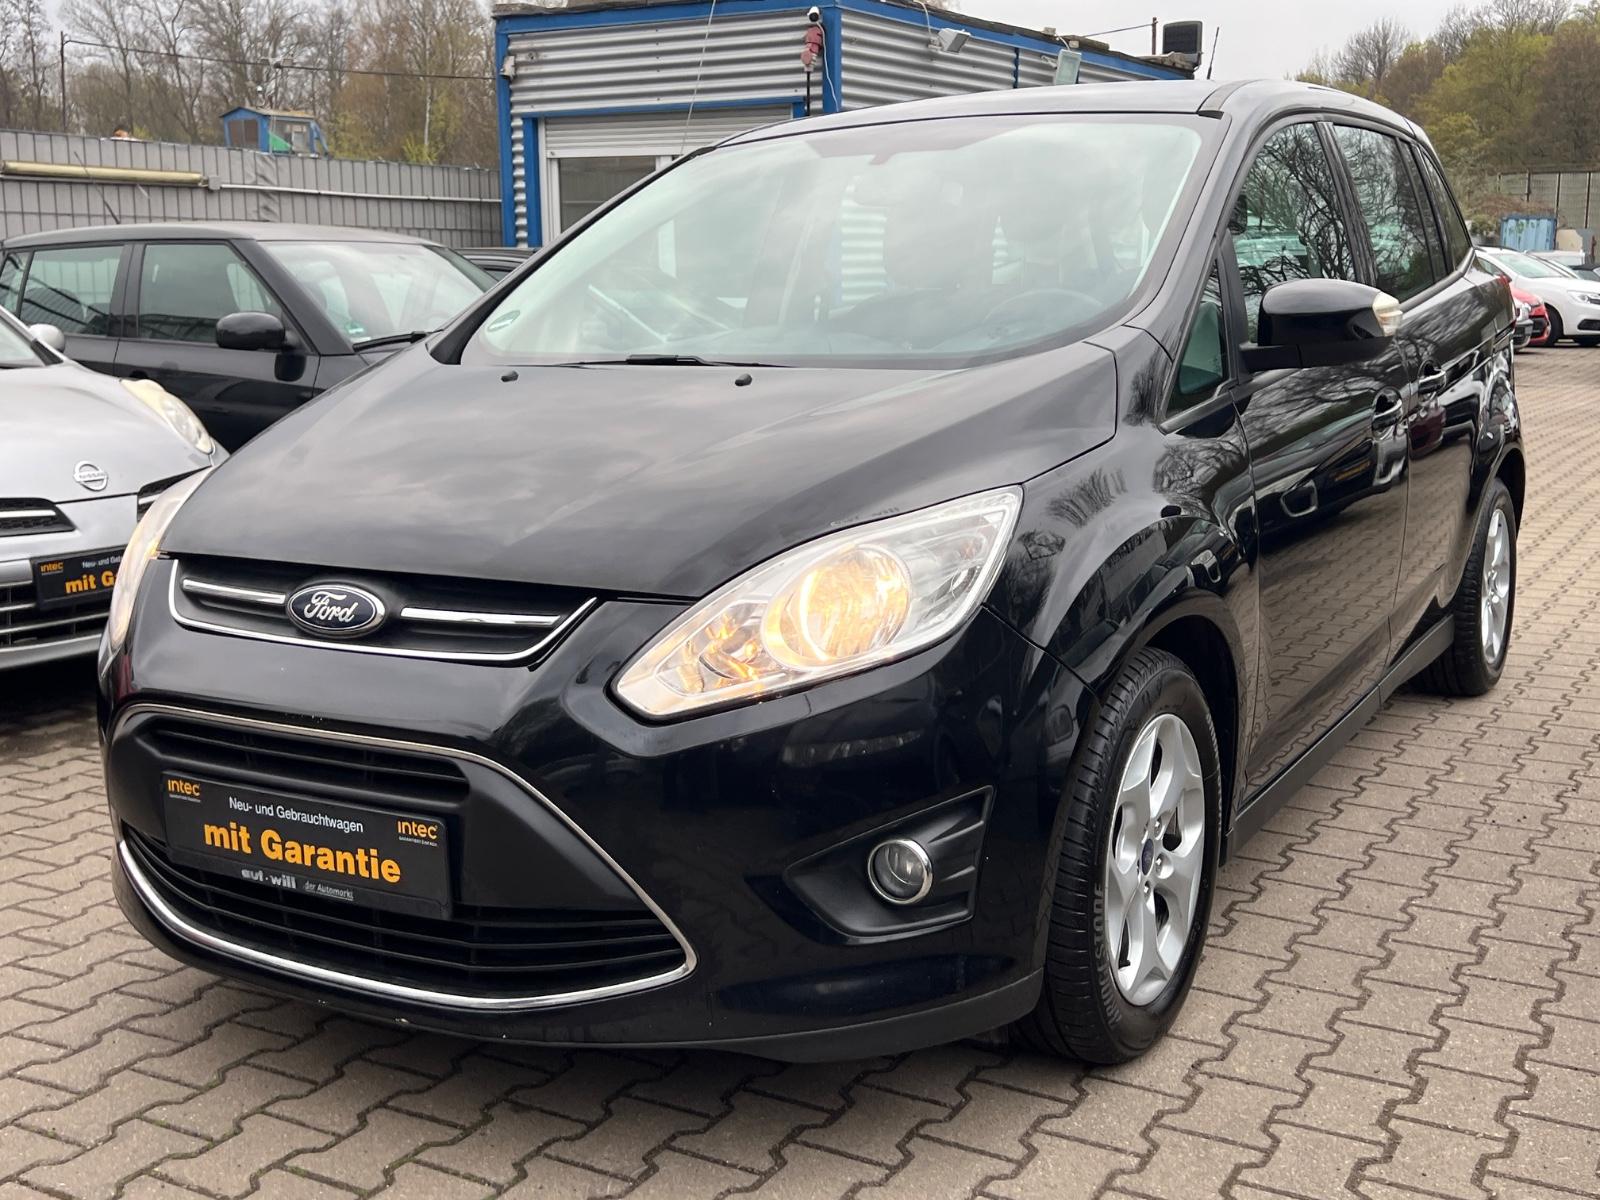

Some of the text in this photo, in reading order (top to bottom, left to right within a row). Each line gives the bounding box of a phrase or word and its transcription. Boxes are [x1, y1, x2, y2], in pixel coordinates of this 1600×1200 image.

[65, 574, 97, 594] mit
[303, 591, 359, 622] Ford
[168, 779, 201, 796] intec
[229, 796, 364, 834] Neu- und Gebrauchtwagen
[397, 820, 438, 840] intec
[203, 821, 401, 884] mit Garantie
